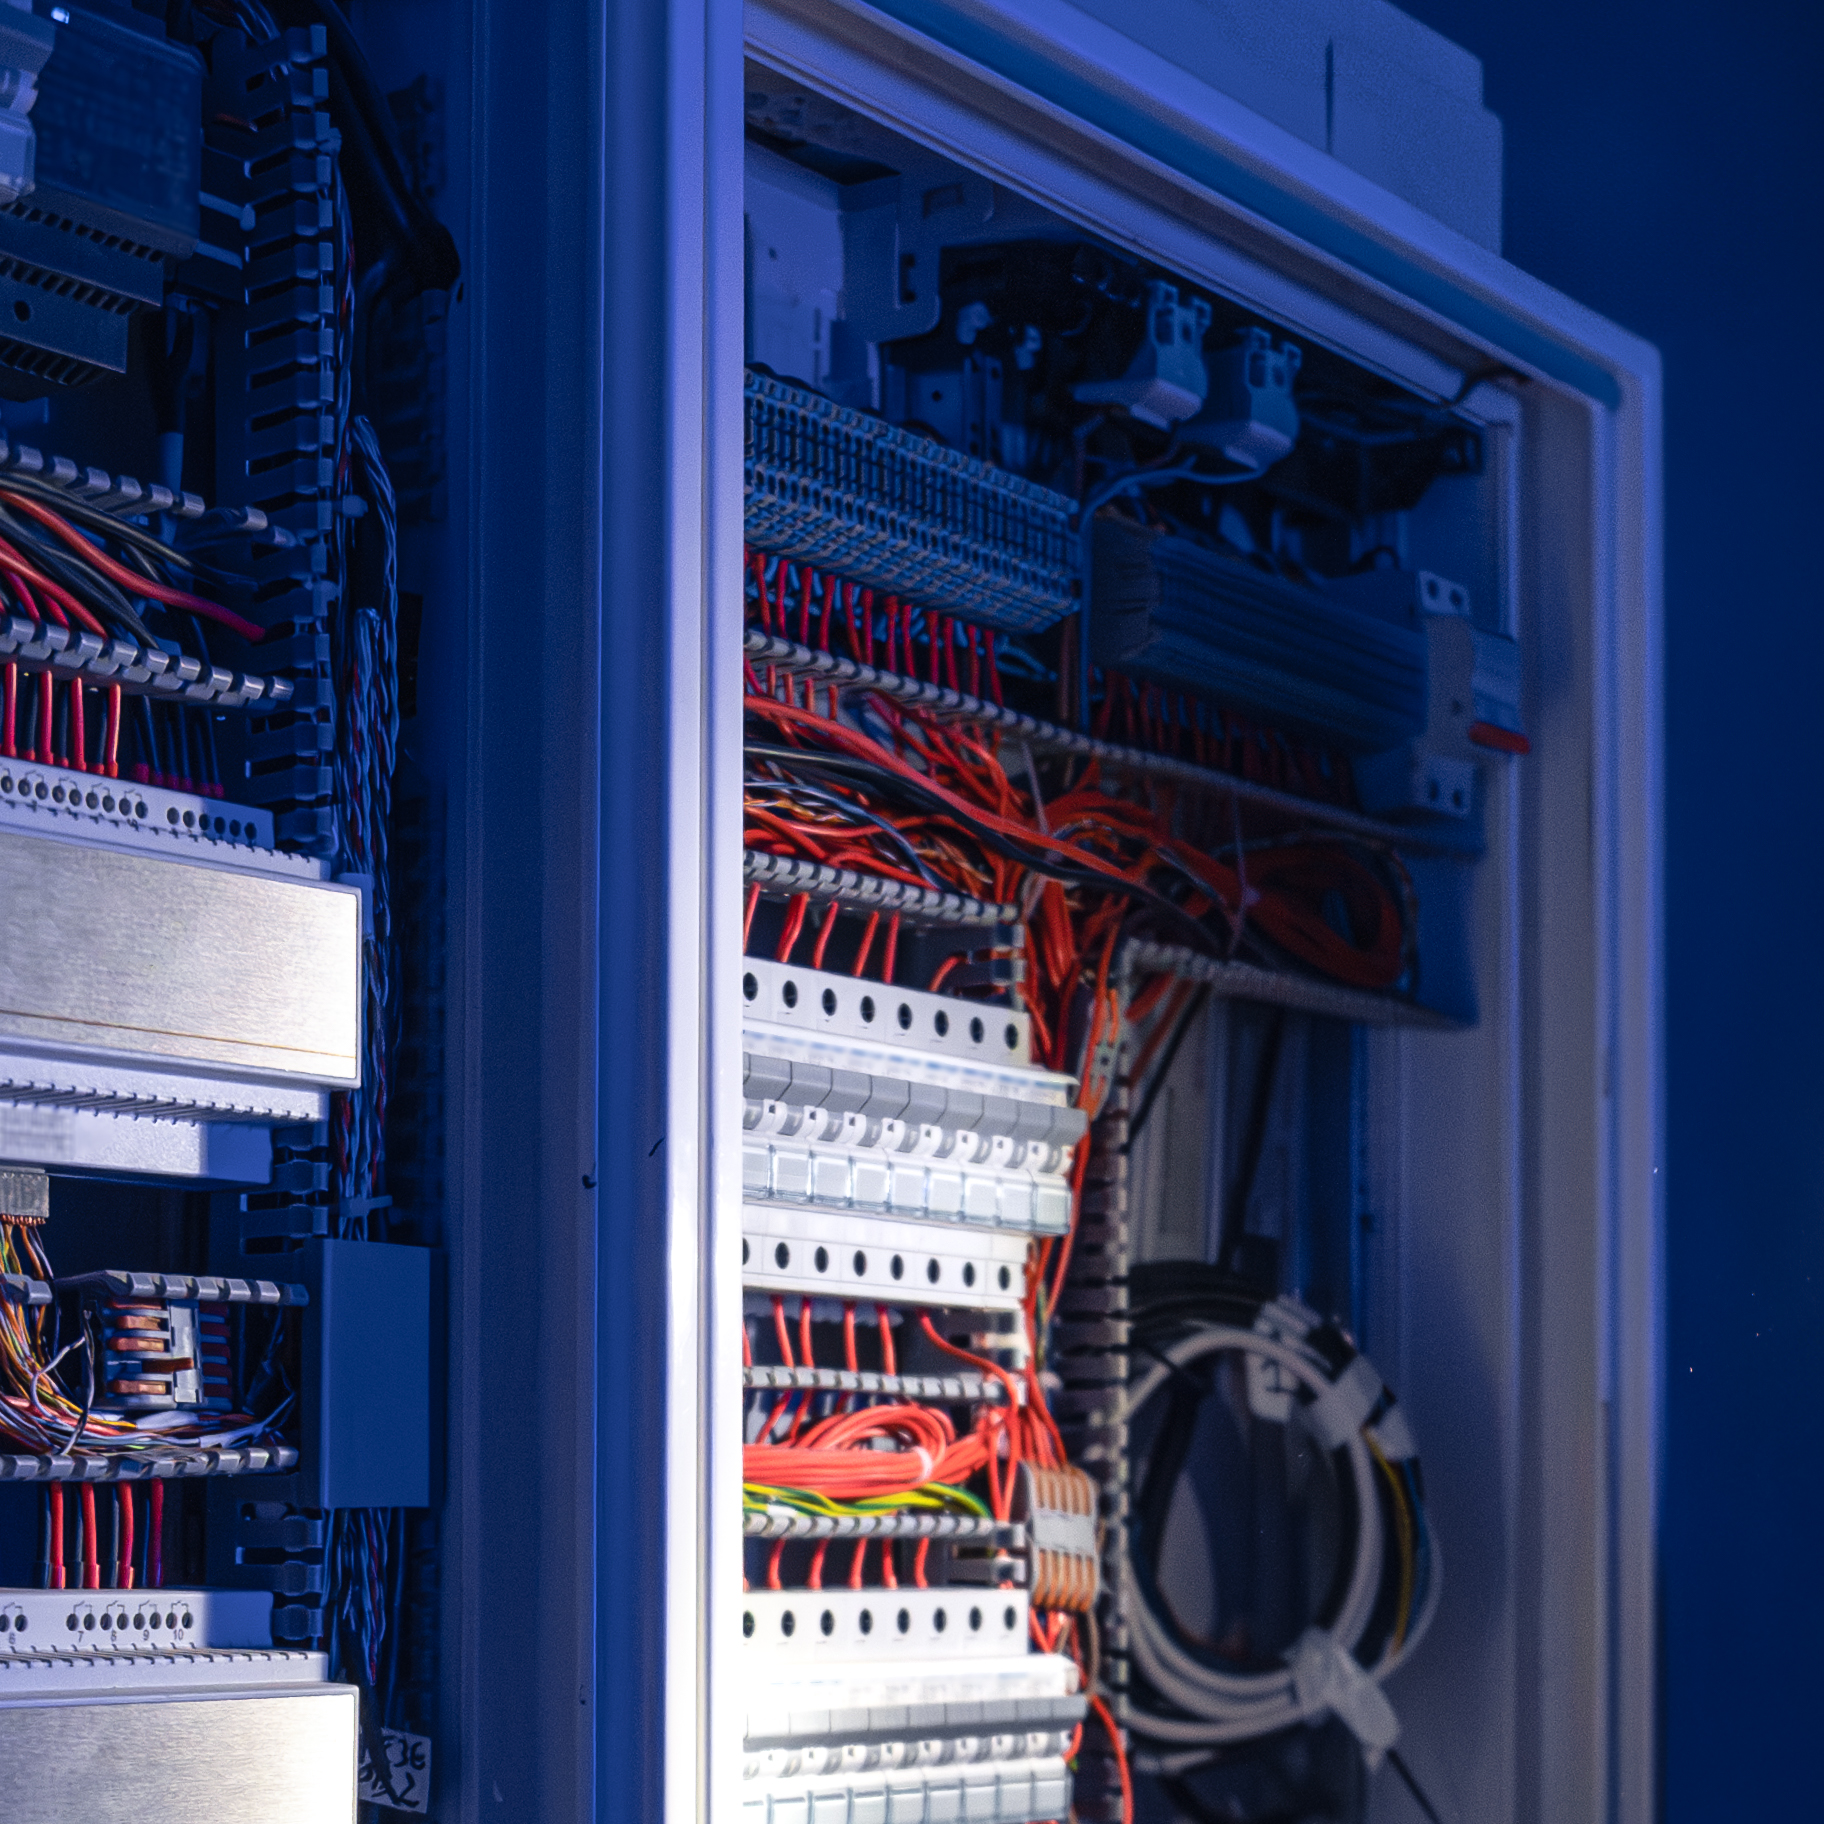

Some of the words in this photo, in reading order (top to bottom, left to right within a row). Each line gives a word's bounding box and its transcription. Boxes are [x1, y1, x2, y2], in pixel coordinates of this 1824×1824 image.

[77, 1630, 84, 1643] 7
[142, 1628, 150, 1642] 9
[173, 1629, 185, 1642] 10
